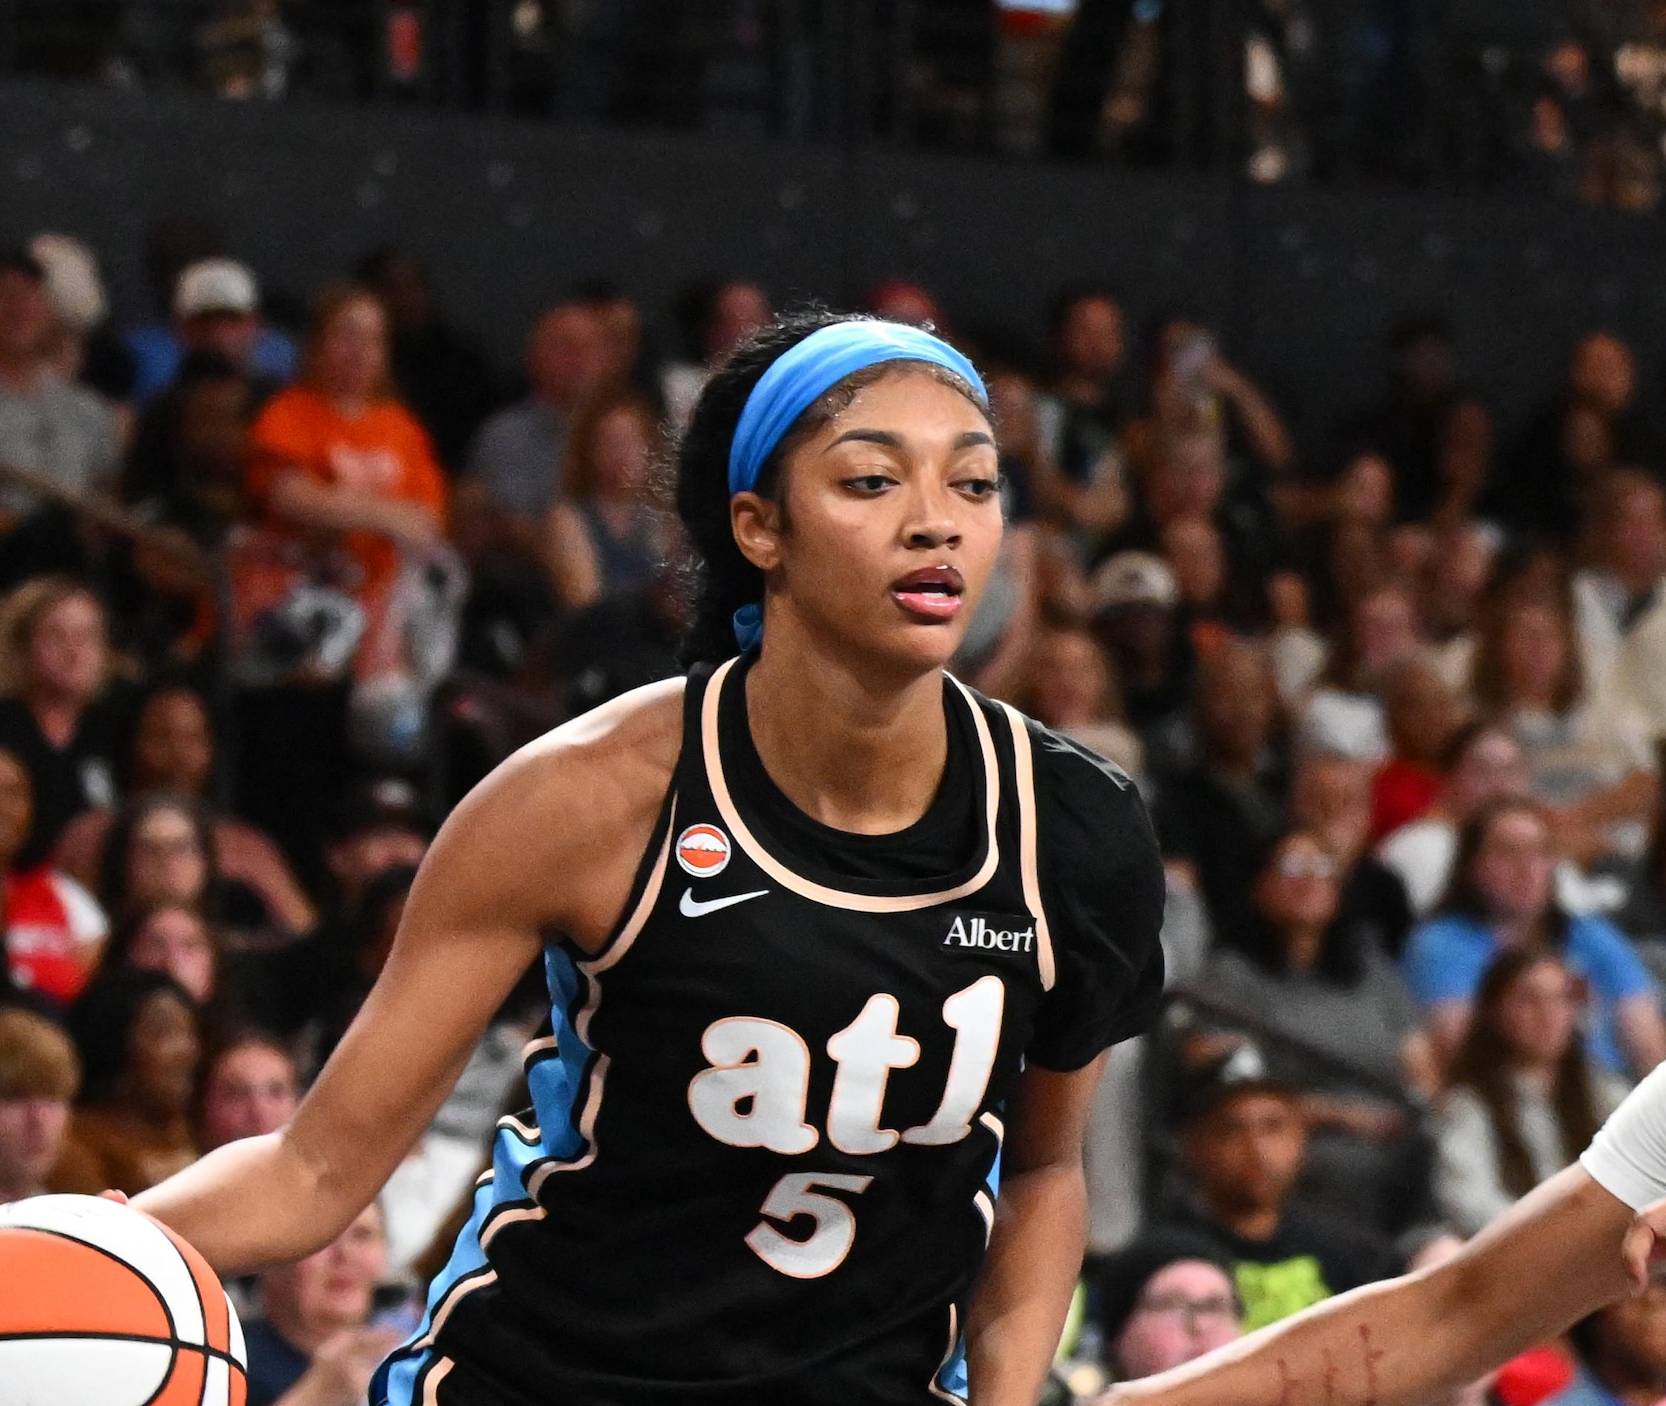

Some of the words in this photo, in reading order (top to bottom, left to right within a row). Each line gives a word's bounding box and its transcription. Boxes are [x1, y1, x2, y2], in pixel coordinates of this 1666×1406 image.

[942, 915, 1034, 953] Albert
[687, 974, 1005, 1156] atl
[743, 1171, 875, 1280] 5
